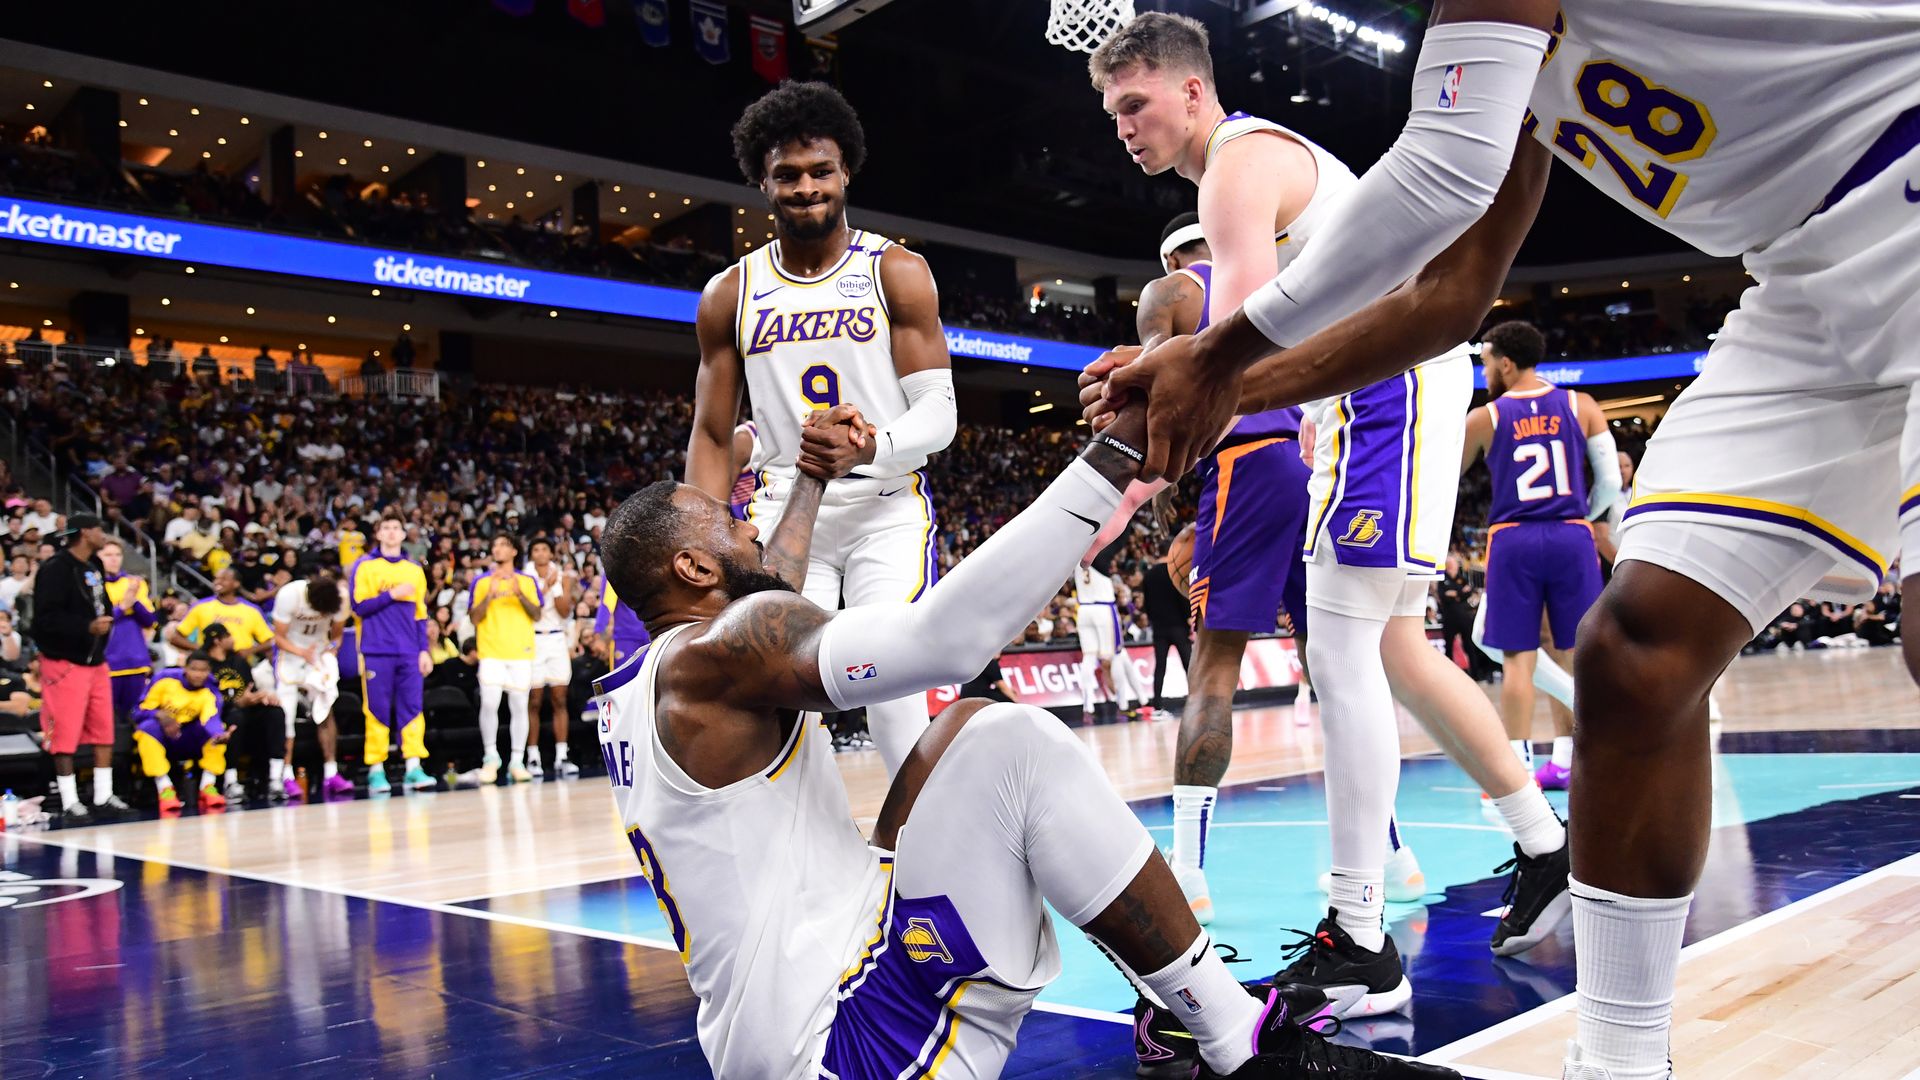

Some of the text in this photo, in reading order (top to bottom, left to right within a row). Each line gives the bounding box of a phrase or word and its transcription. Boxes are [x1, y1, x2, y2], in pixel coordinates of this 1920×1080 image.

[1551, 58, 1718, 220] 28
[373, 255, 531, 298] ticketmaster
[839, 280, 871, 291] bibigo
[746, 306, 878, 357] LAKERS
[945, 331, 1033, 361] icketmaster
[799, 359, 842, 416] 9
[1108, 438, 1144, 461] PROMISE
[1513, 415, 1562, 440] JONES
[1513, 439, 1573, 502] 21
[601, 740, 635, 789] ME
